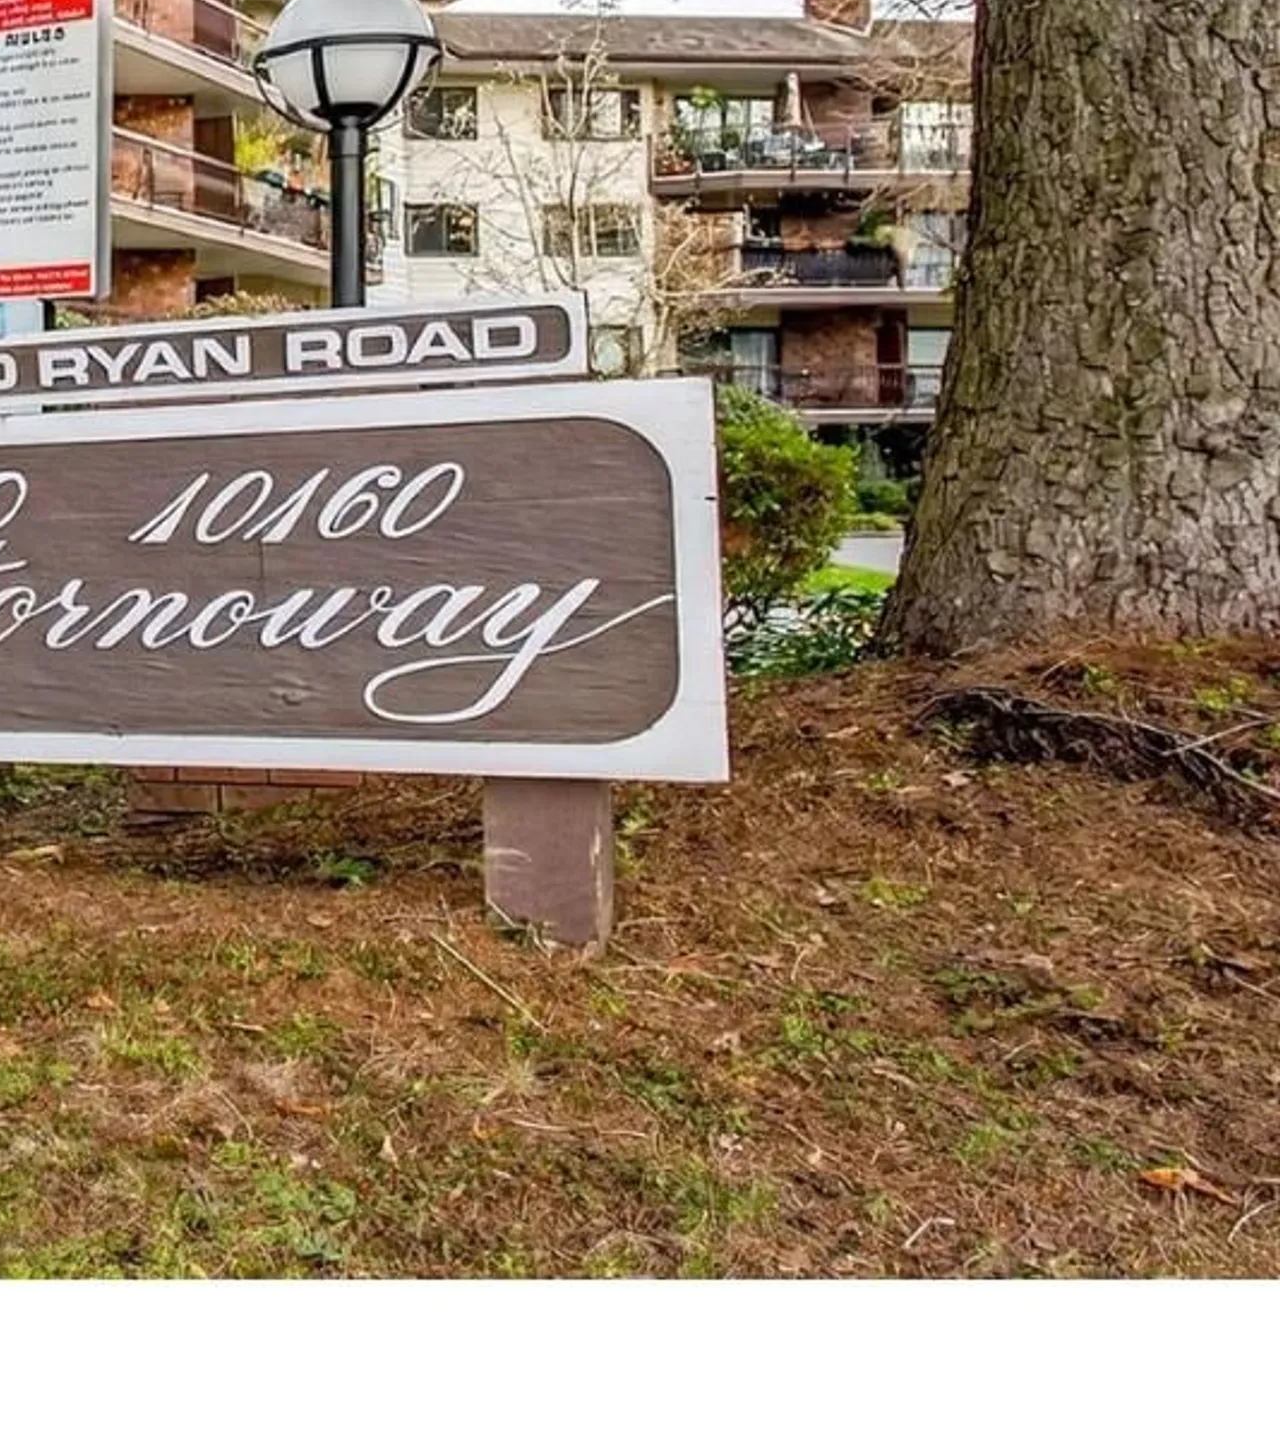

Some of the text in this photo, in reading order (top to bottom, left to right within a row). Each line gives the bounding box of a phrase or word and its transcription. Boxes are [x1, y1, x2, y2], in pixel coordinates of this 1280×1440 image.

[37, 334, 251, 389] RYAN
[286, 314, 537, 372] ROAD
[127, 462, 464, 545] 10160
